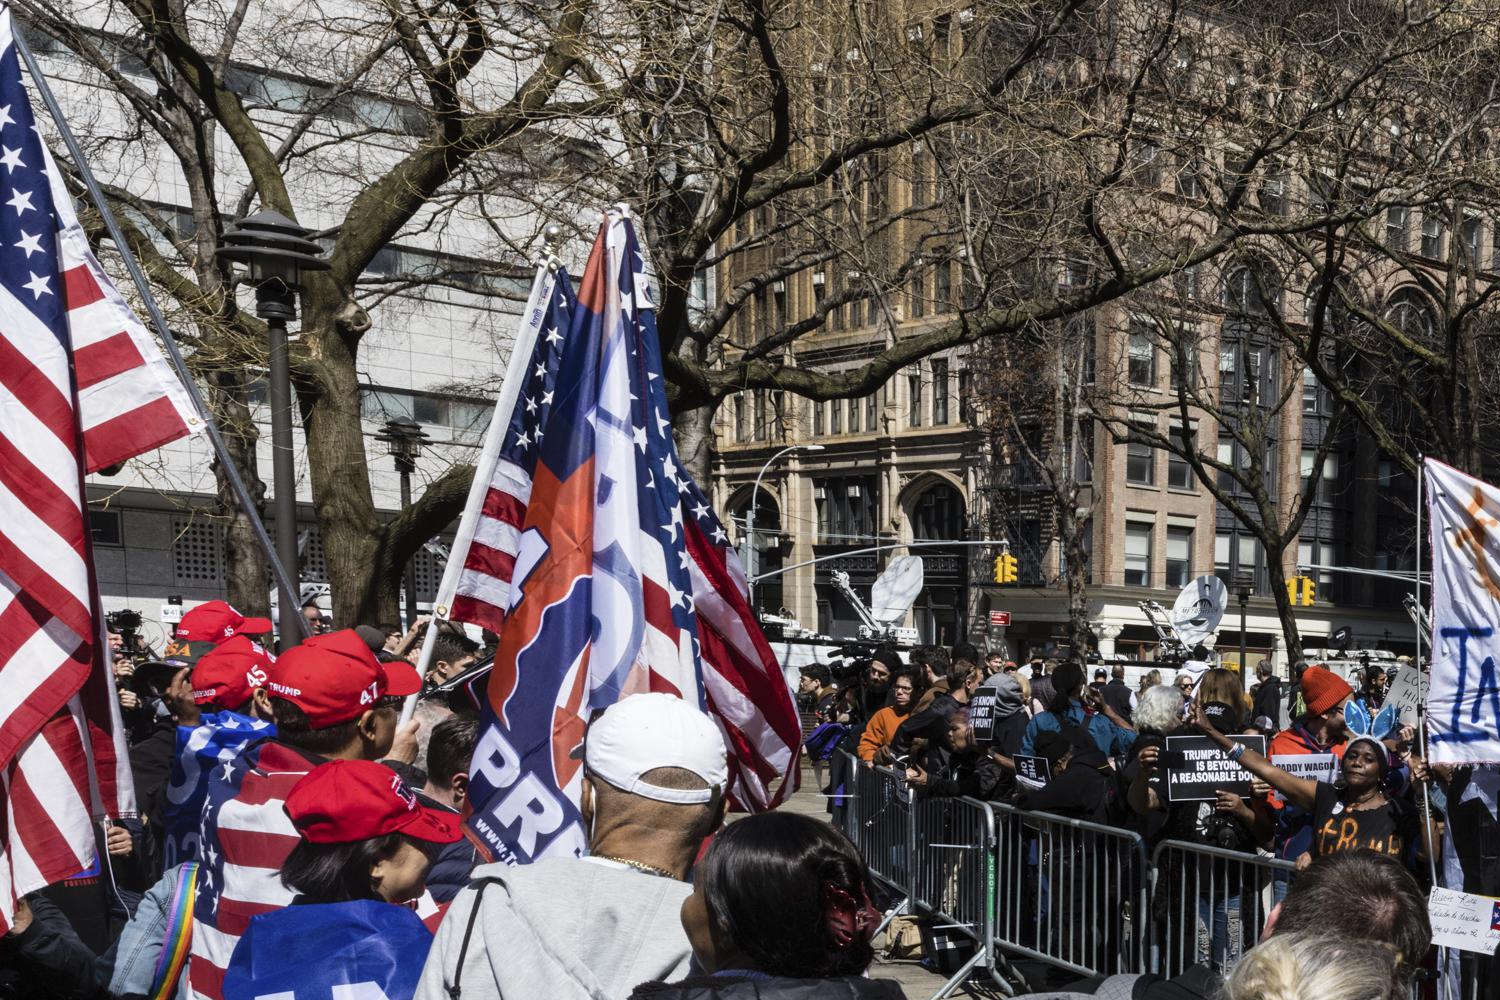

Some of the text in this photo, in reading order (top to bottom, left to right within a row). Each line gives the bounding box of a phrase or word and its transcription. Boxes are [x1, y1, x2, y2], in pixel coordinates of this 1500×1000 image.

[224, 625, 234, 637] 45
[164, 643, 191, 657] SA
[246, 664, 268, 688] 45
[269, 682, 302, 697] TRUMP
[359, 682, 378, 706] 47
[978, 696, 996, 706] KNOW
[977, 707, 989, 717] NOT
[974, 718, 992, 729] HUNT
[1183, 749, 1221, 761] TRUMP'S
[1020, 761, 1028, 775] OF
[1029, 758, 1037, 779] THE
[1196, 760, 1242, 772] IS BEYOND
[1305, 761, 1335, 772] WAGON
[1171, 773, 1179, 784] A
[1179, 771, 1237, 784] REASONABLE
